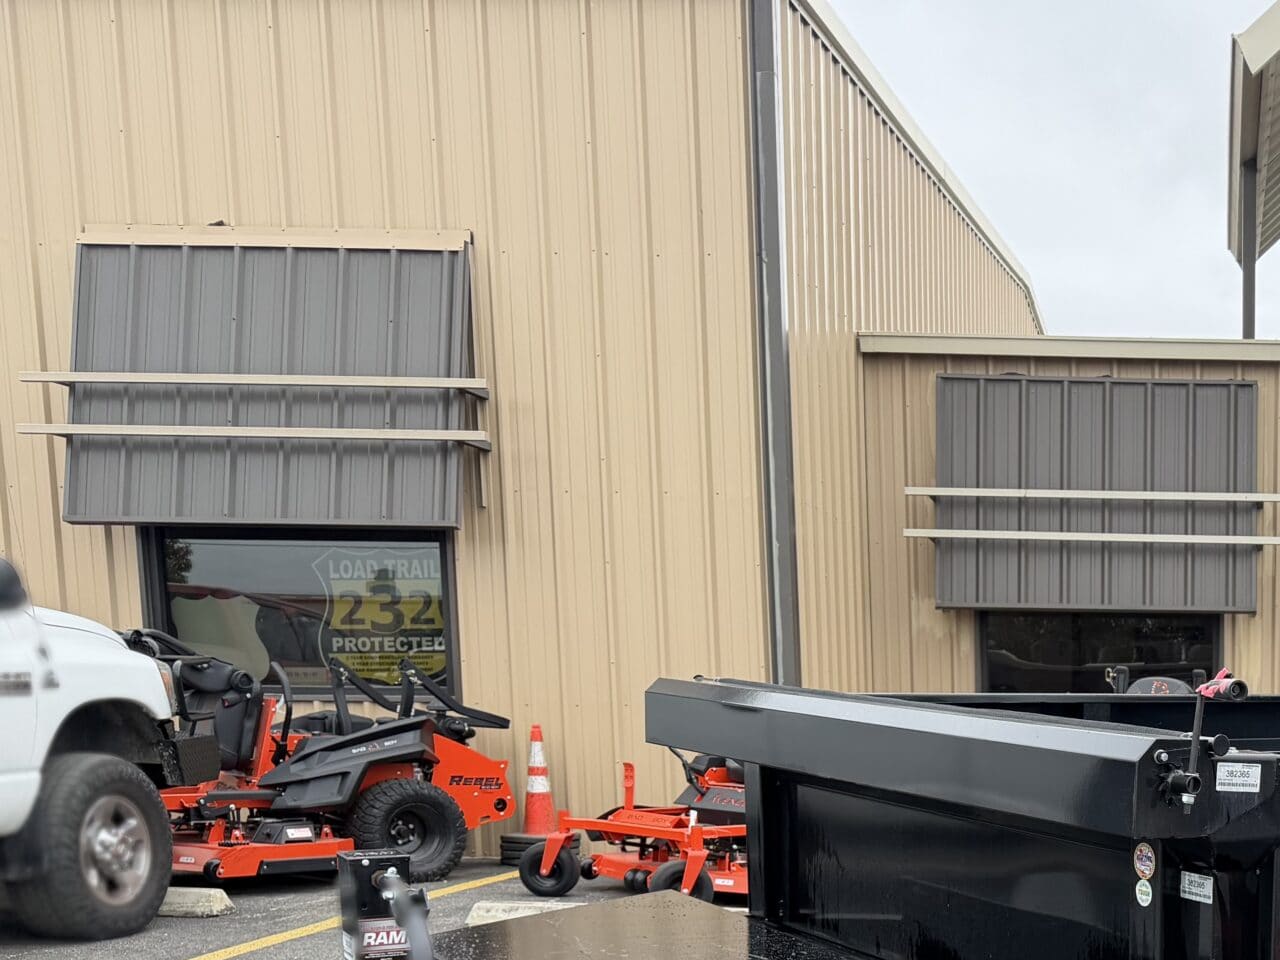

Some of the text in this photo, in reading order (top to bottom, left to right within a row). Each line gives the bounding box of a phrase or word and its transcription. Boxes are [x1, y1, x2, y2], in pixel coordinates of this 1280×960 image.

[329, 560, 440, 579] LOAD TRAIL
[339, 584, 436, 633] 232
[332, 637, 446, 652] PROTECTED
[449, 775, 502, 787] REBEL
[1225, 769, 1250, 779] 382365
[362, 930, 407, 947] RAM
